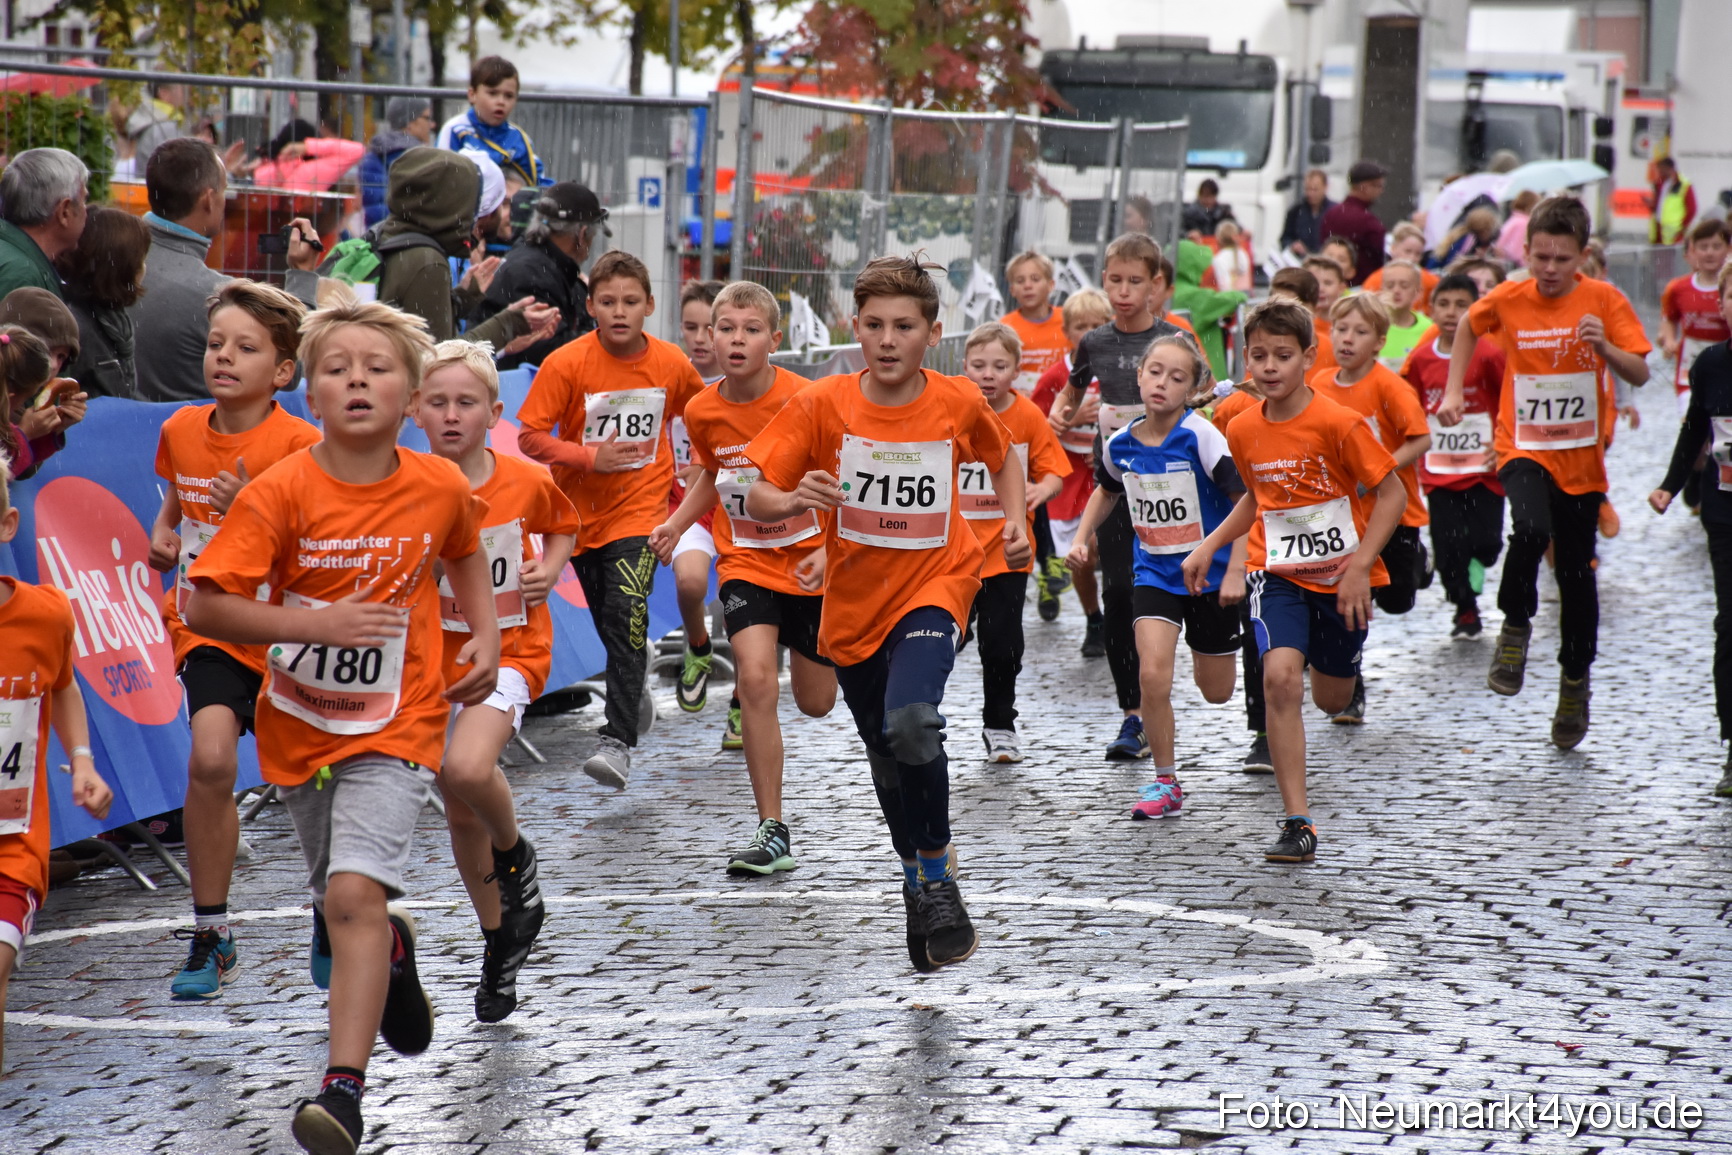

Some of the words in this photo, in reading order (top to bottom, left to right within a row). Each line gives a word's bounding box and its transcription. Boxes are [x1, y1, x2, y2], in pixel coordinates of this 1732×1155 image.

[1517, 327, 1573, 339] Neumarkter
[1517, 338, 1562, 350] Stadtlauf
[1526, 396, 1585, 420] 7172
[596, 413, 654, 437] 7183
[1543, 428, 1569, 437] Jonas
[1435, 432, 1481, 451] 7023
[883, 451, 922, 462] BOCK
[856, 470, 936, 508] 7156
[1136, 497, 1187, 523] 7206
[755, 522, 787, 535] Marcel
[879, 517, 908, 530] Leon
[298, 535, 393, 551] Neumarkter
[1280, 526, 1345, 559] 7058
[297, 553, 373, 571] Stadtlauf
[1292, 563, 1339, 577] Johannes
[724, 599, 748, 615] adidas
[905, 629, 945, 639] saller
[287, 643, 383, 685] 7180
[103, 659, 153, 698] SPORTS
[294, 685, 366, 712] Maximilian
